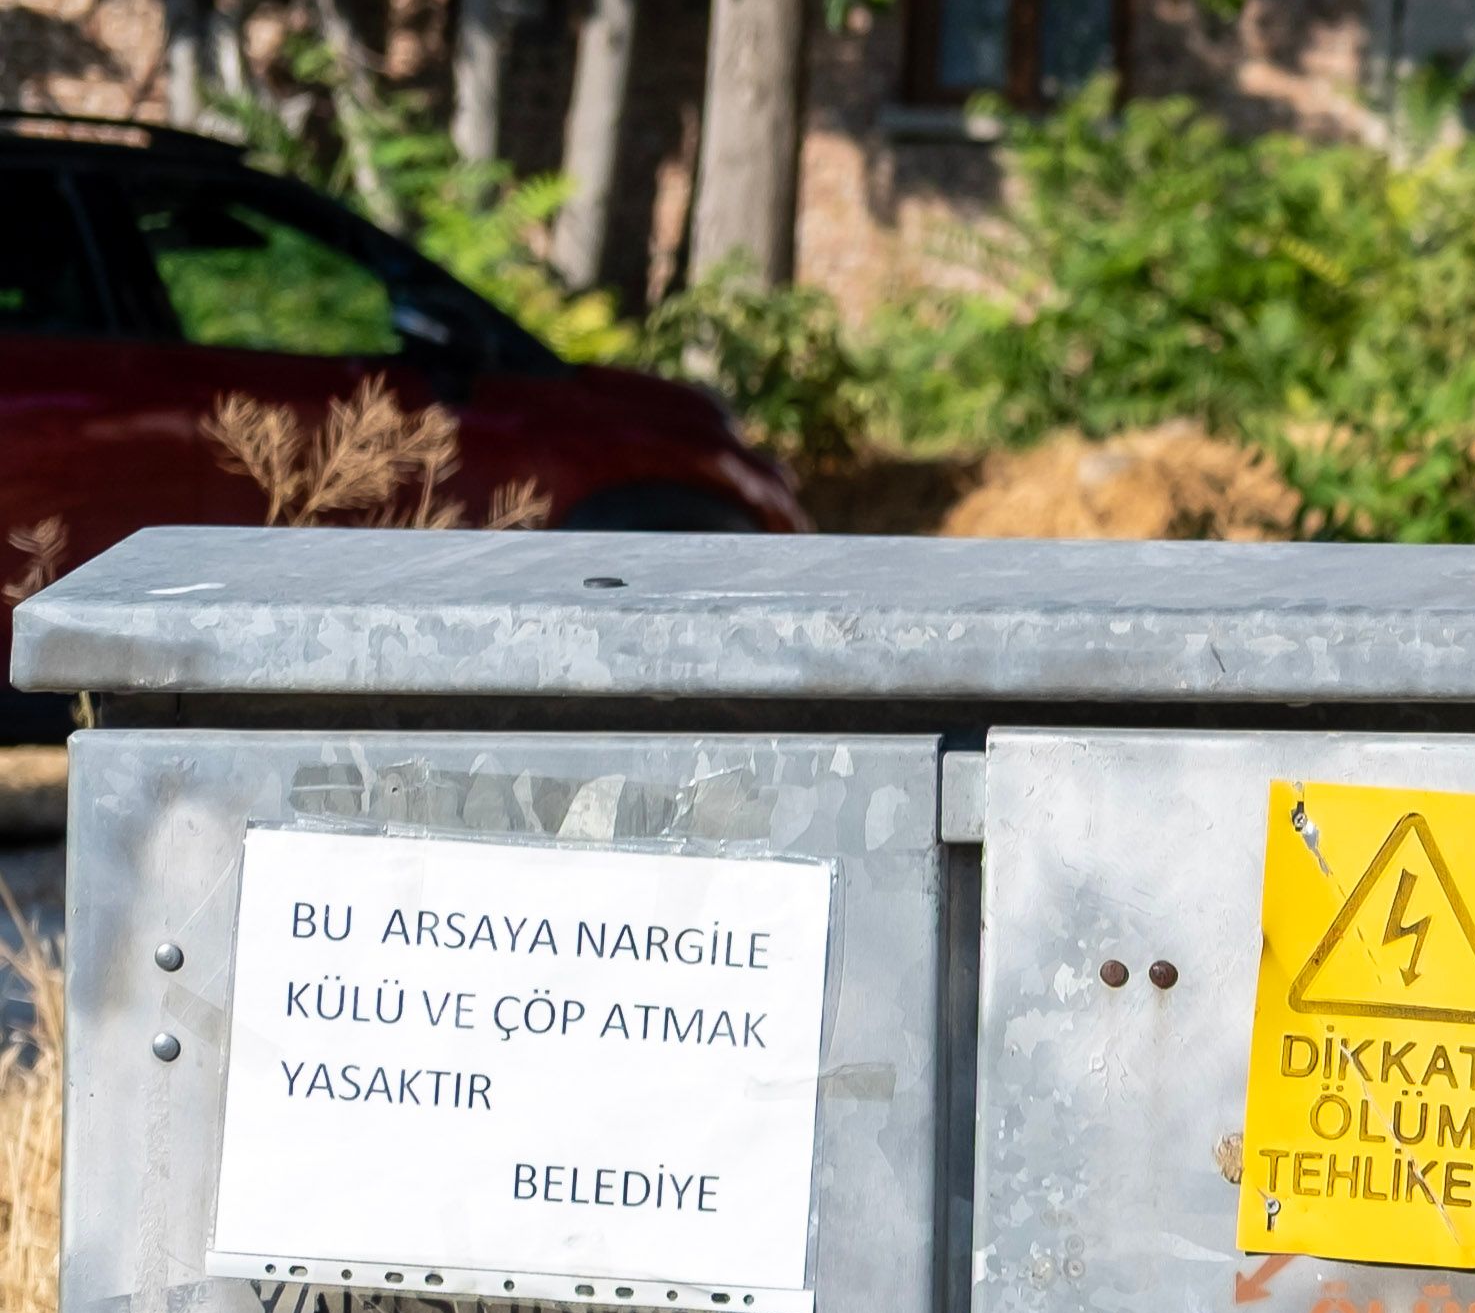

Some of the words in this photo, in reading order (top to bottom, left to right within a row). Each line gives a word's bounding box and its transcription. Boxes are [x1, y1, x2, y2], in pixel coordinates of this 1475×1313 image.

[293, 902, 352, 941] BU
[381, 909, 558, 956] ARSAYA
[576, 920, 770, 969] NARGİLE
[286, 975, 405, 1024] KÜLÜ
[422, 990, 475, 1029] VE
[493, 988, 586, 1041] ÇÖP
[601, 1003, 766, 1048] ATMAK
[281, 1060, 492, 1110] YASAKTIR
[513, 1163, 720, 1212] BELEDİYE
